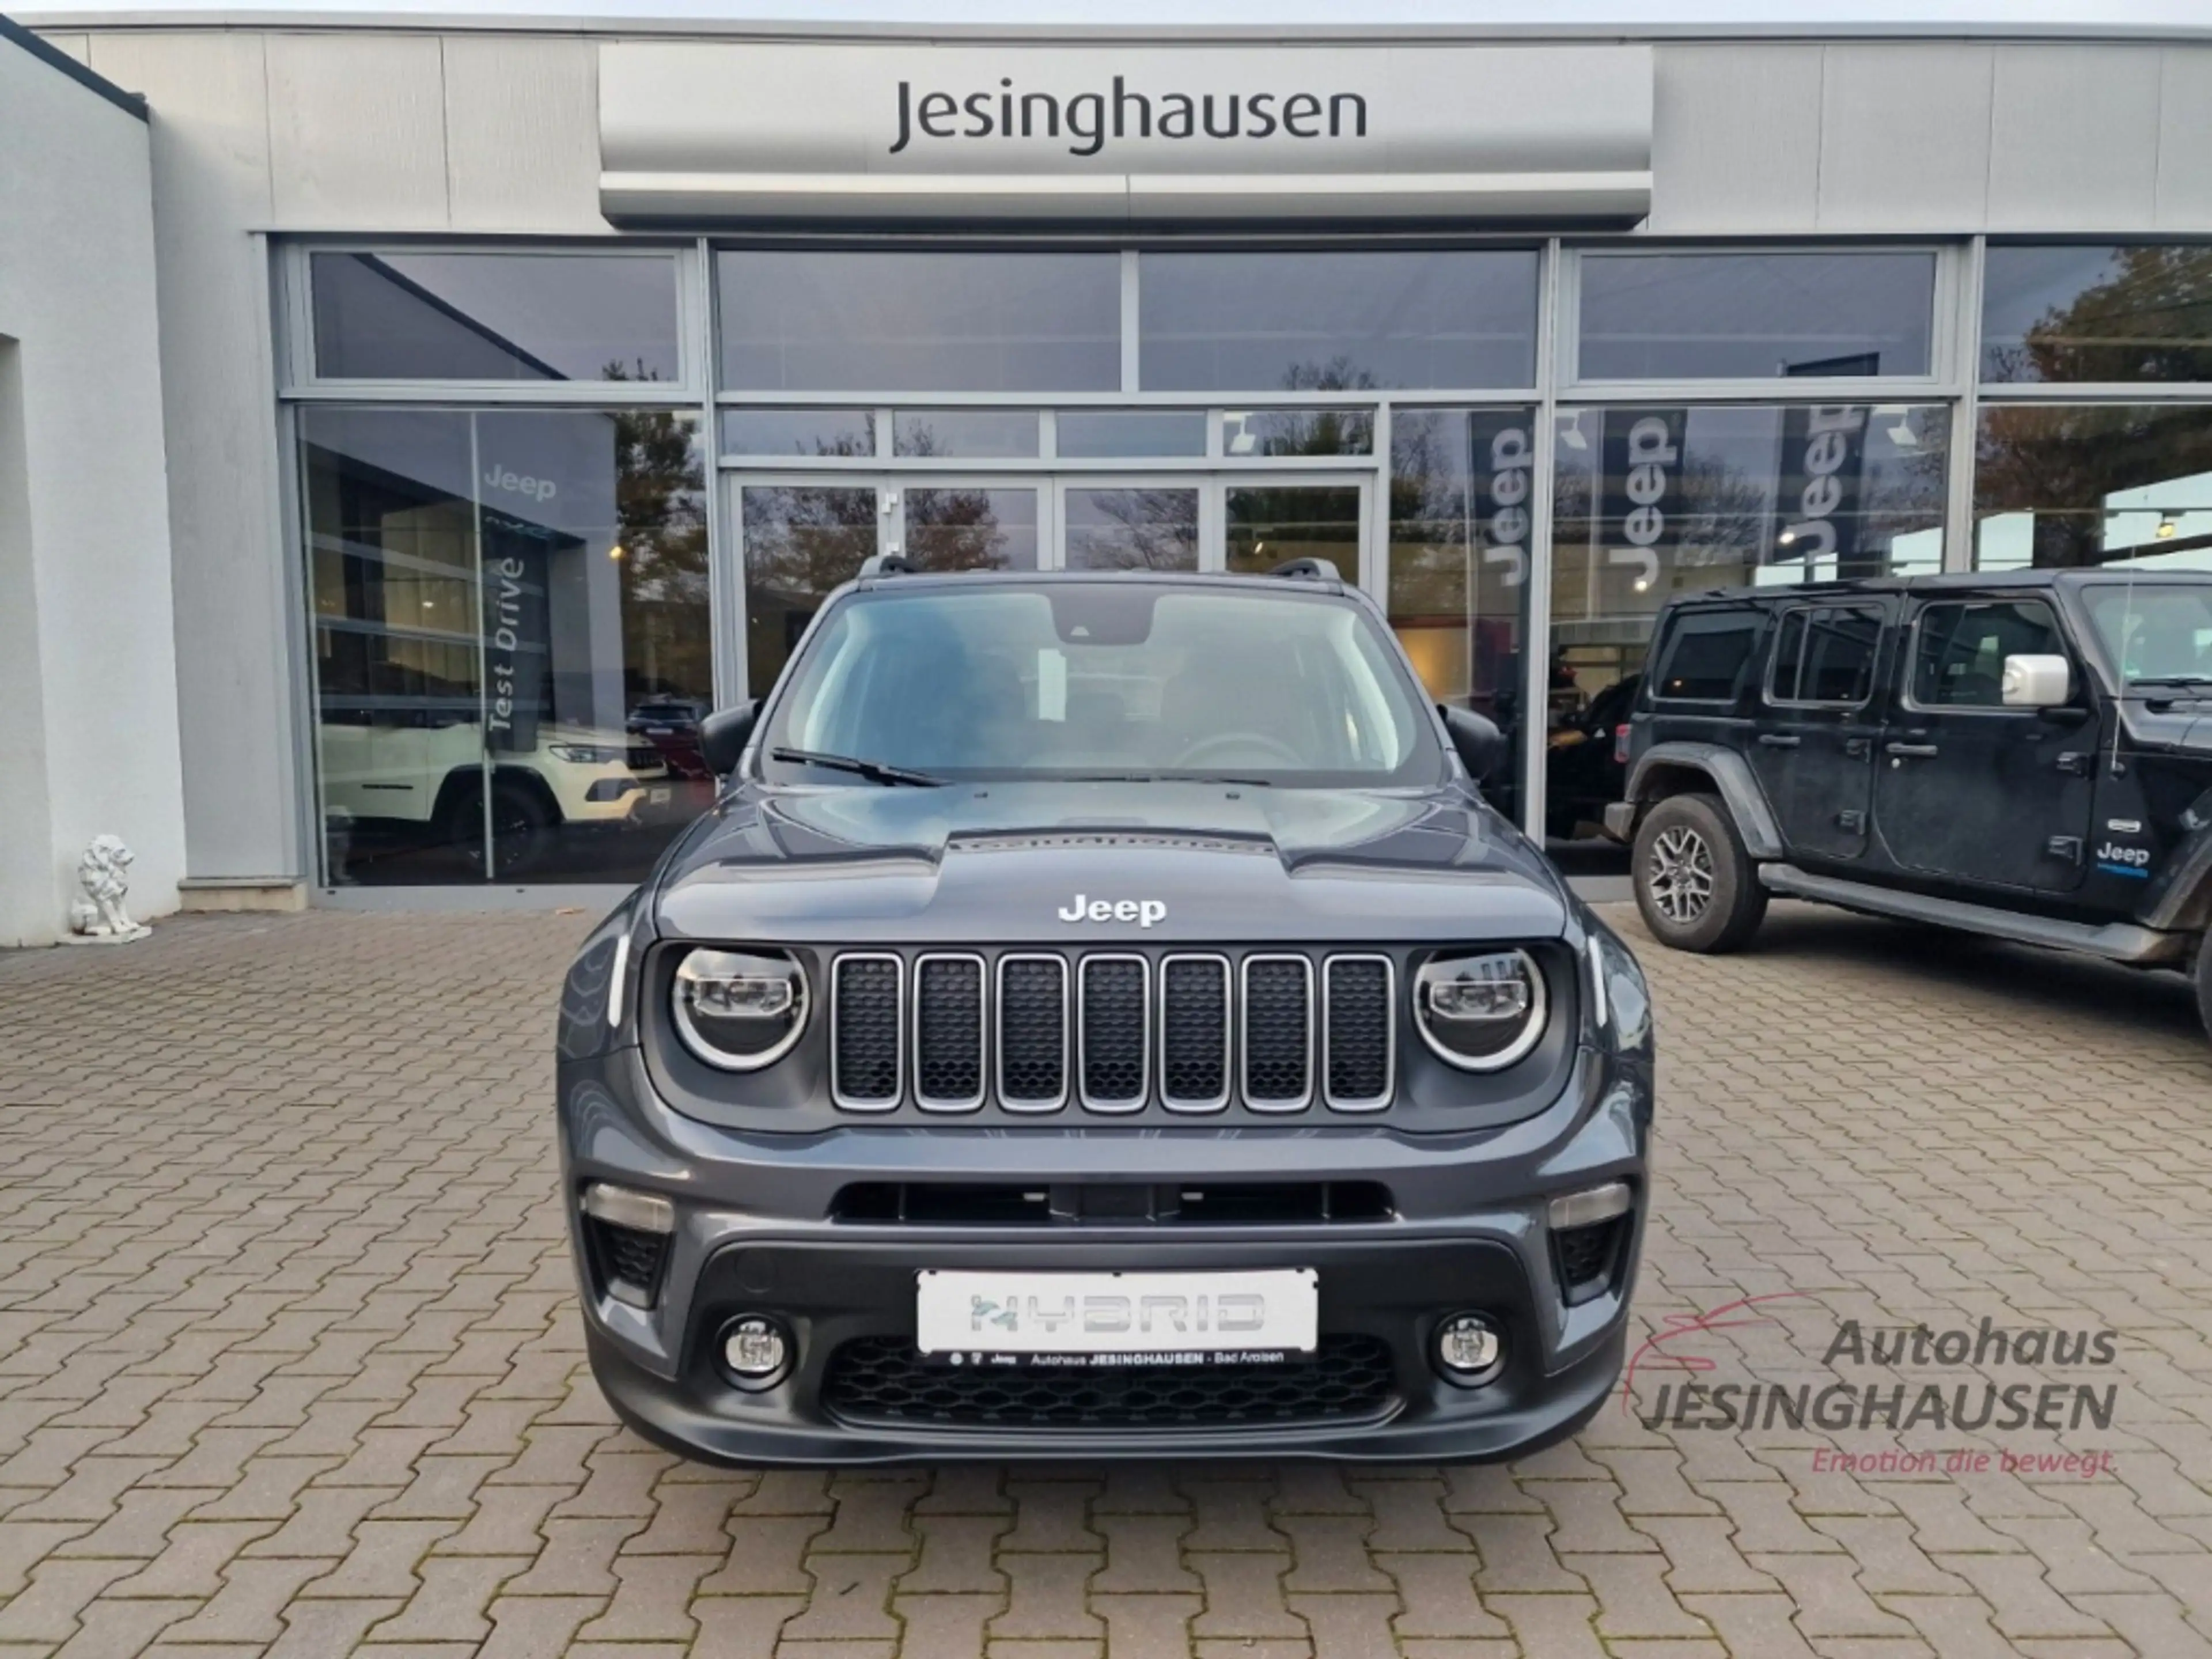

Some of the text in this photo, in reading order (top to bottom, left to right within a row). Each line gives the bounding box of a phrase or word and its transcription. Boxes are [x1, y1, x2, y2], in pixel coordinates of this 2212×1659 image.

[889, 75, 1367, 156] Jesinghausen
[484, 465, 557, 502] Jeep
[1484, 427, 1533, 587] Jeep
[1609, 416, 1677, 592] Jeep
[488, 556, 524, 732] Test Drive
[2097, 842, 2150, 867] Jeep
[1058, 894, 1167, 929] Jeep
[971, 1293, 1266, 1332] HYBRID
[1031, 1354, 1086, 1366] Autohaus
[1089, 1353, 1204, 1366] JESINGHAUSEN
[1214, 1351, 1238, 1364] Bad
